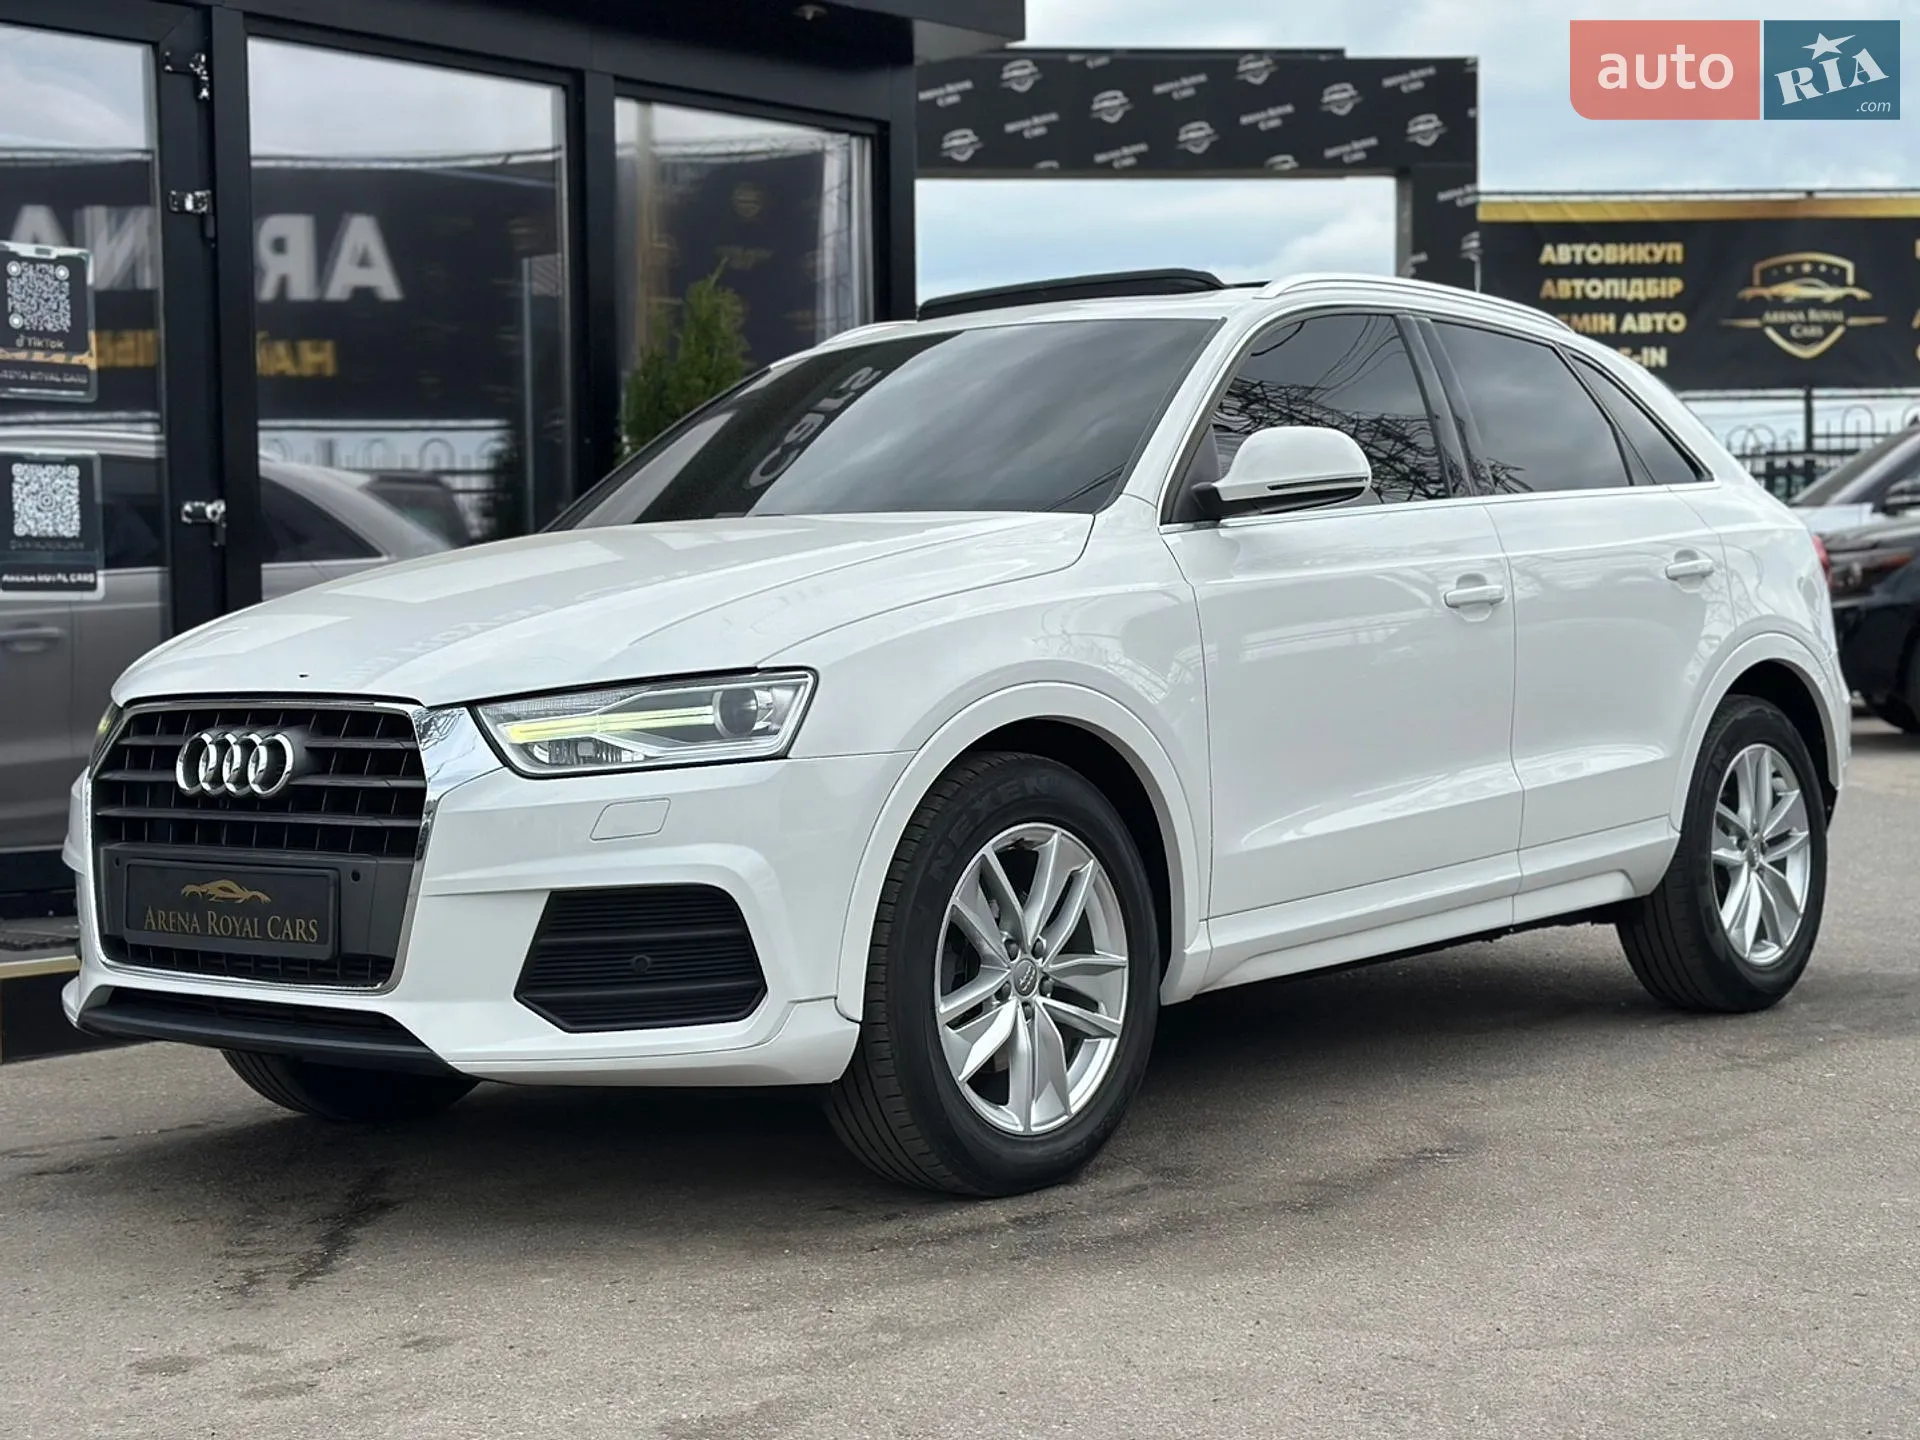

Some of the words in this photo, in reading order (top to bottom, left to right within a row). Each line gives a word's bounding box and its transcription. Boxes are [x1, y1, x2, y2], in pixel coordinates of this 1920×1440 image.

[1540, 242, 1684, 264] АВТОВИКУП
[1539, 277, 1684, 302] АВТОПІДБІР
[1619, 312, 1687, 334] АВТО
[28, 337, 64, 349] TikTok
[144, 905, 201, 934] ARENA
[206, 910, 263, 939] ROYAL
[267, 914, 319, 943] CARS
